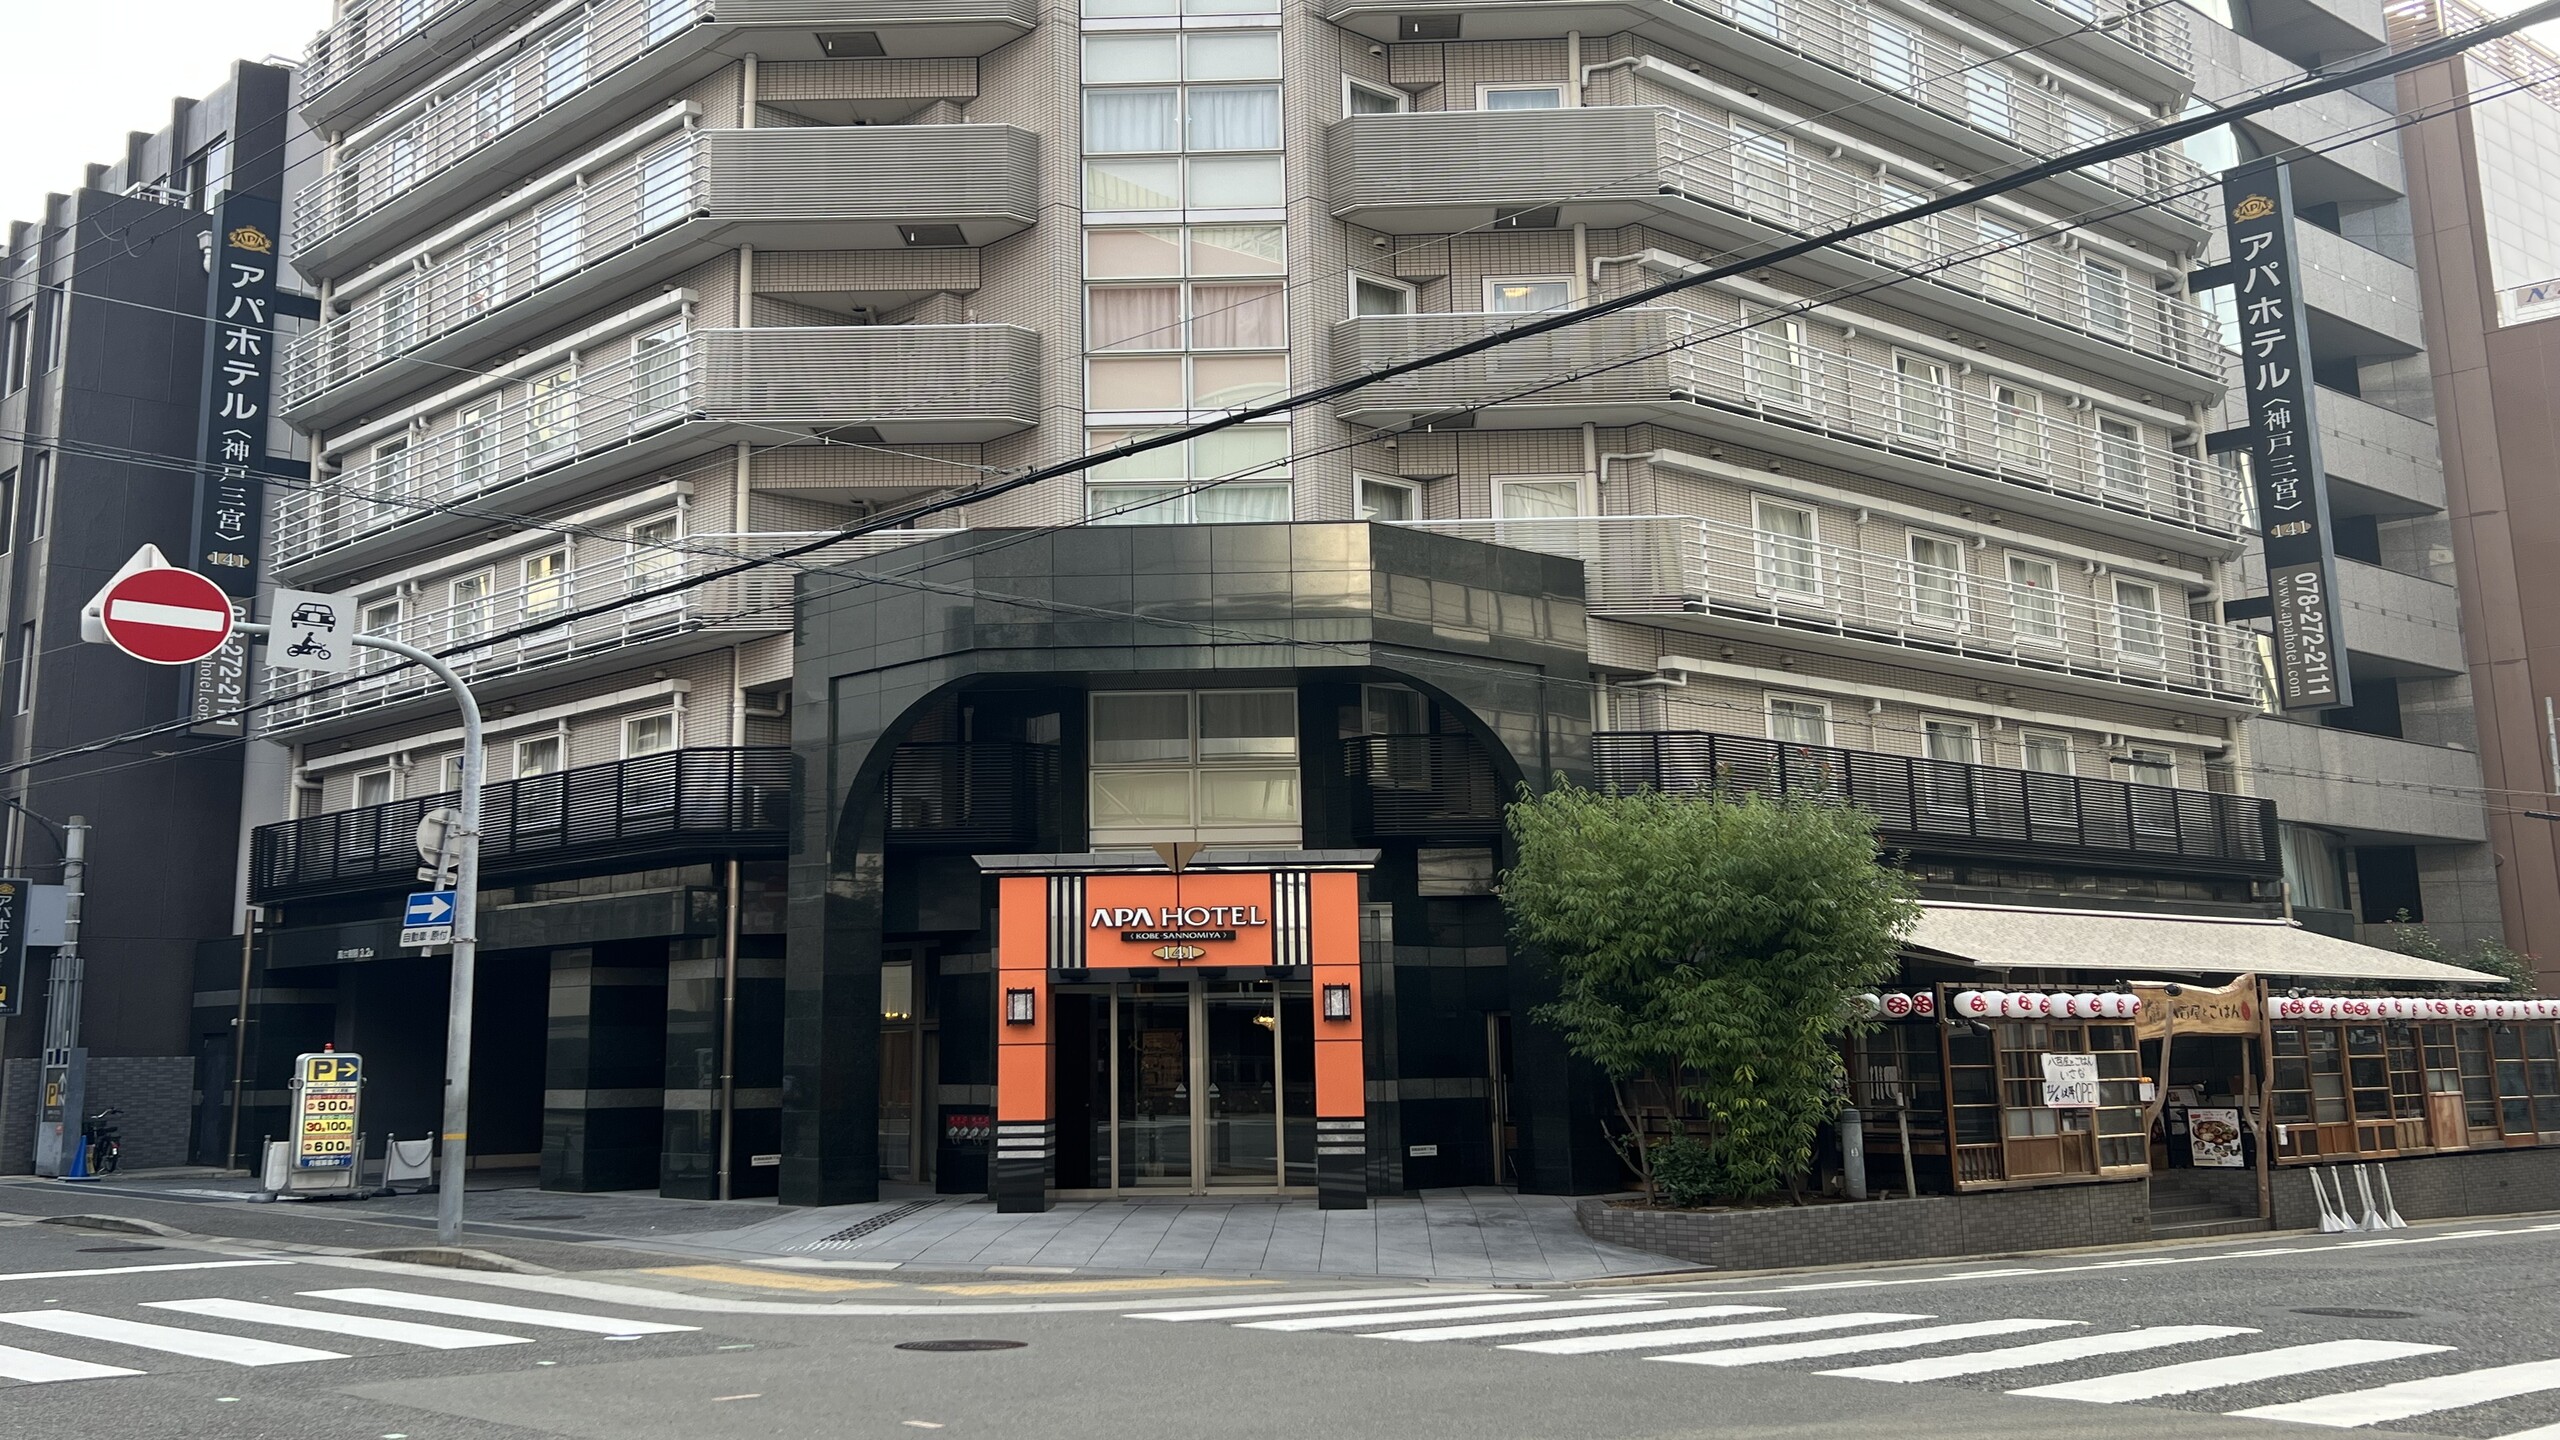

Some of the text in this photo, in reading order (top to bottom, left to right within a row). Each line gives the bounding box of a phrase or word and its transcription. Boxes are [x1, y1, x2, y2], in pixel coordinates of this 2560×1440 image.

[2240, 231, 2290, 391] アパホテル
[219, 263, 265, 420] アパホテル
[2275, 520, 2308, 538] 141
[211, 551, 246, 568] 141
[2277, 575, 2302, 698] www.apahotel.com
[2294, 572, 2331, 695] 078-272-2111
[1091, 905, 1267, 928] APA HOTEL
[1163, 945, 1194, 960] 141
[314, 1061, 332, 1079] P
